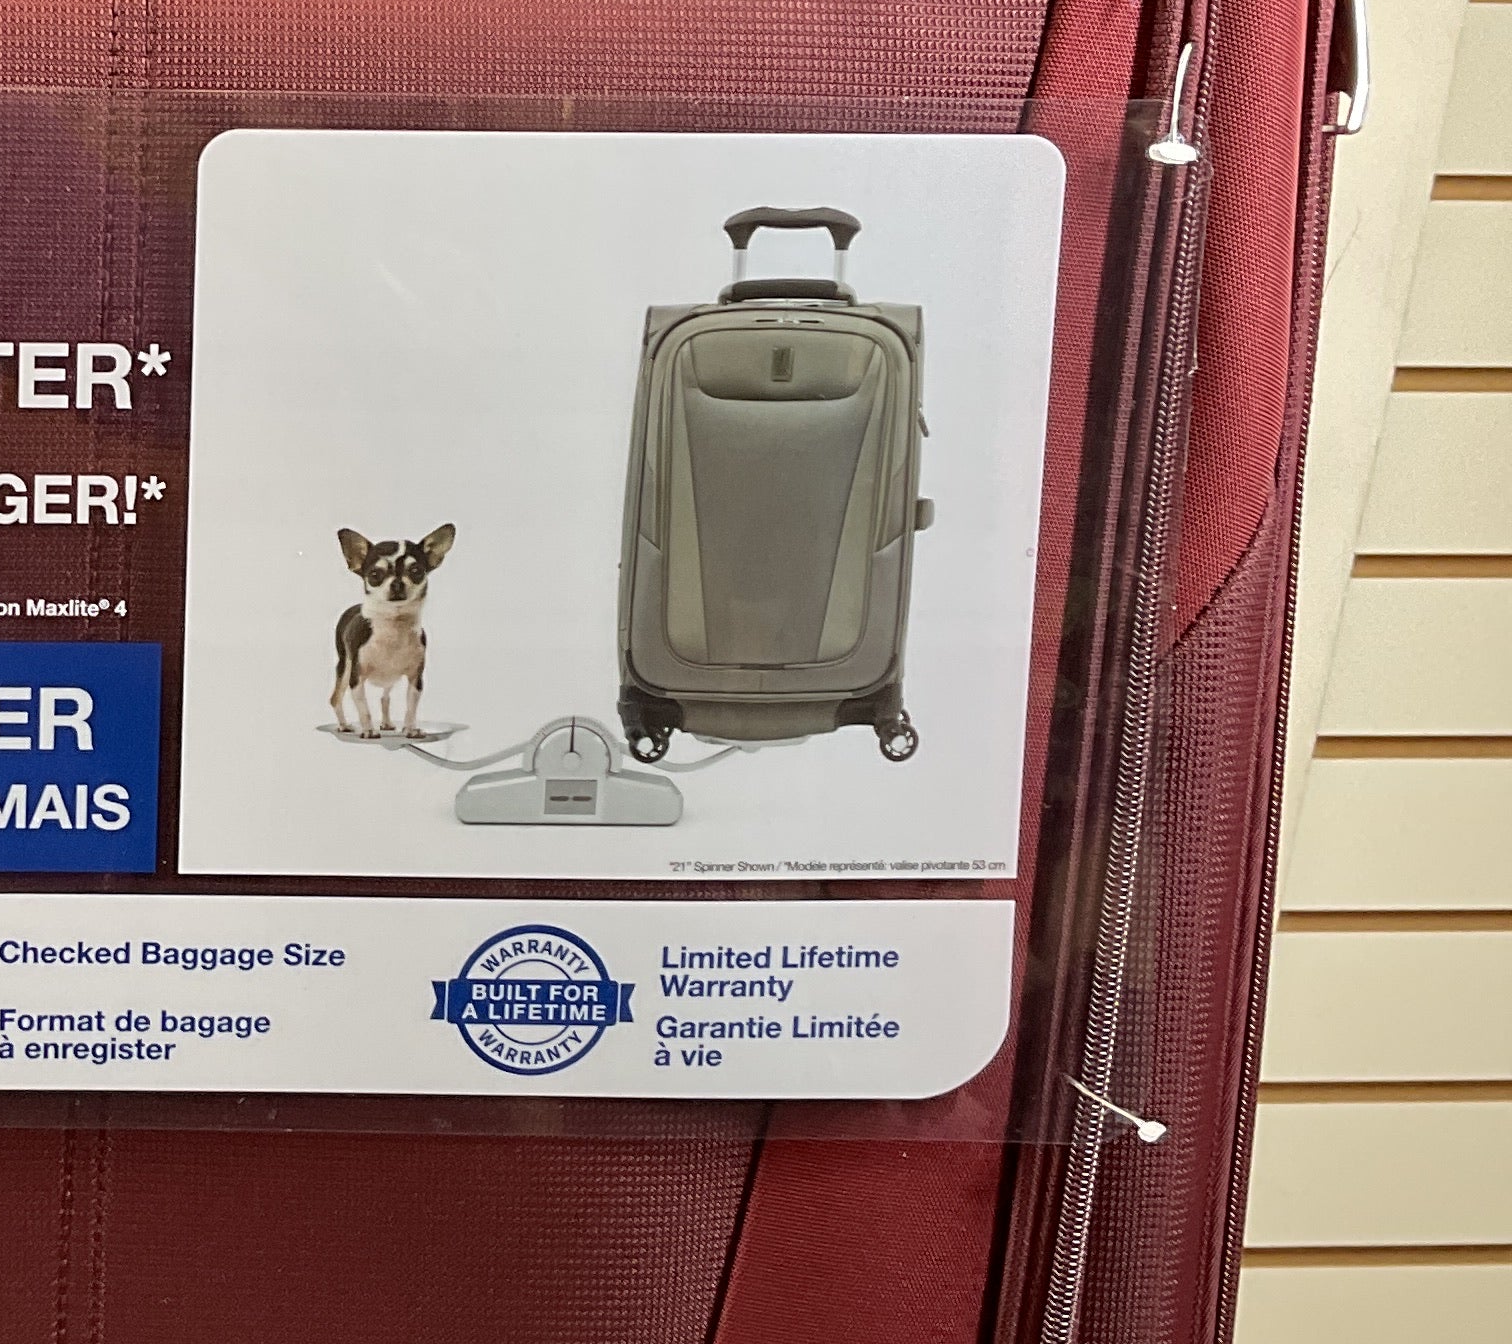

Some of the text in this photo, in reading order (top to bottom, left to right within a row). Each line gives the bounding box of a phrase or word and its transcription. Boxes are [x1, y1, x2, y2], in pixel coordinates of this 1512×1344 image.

[114, 600, 127, 618] 4
[737, 861, 775, 872] Shown
[141, 942, 274, 970] Baggage
[283, 943, 346, 967] Size
[480, 939, 590, 974] WARRANTY
[662, 945, 899, 969] Limited Lifetime
[471, 983, 599, 1002] BUILT FOR
[660, 974, 794, 1002] Warranty
[115, 1010, 151, 1032] de
[161, 1010, 271, 1038] bagage
[461, 1002, 607, 1021] A LIFETIME
[656, 1013, 900, 1039] Garantie Limitée
[25, 1038, 176, 1065] enregister
[478, 1029, 583, 1065] WARRANTY
[654, 1042, 723, 1067] à vie
